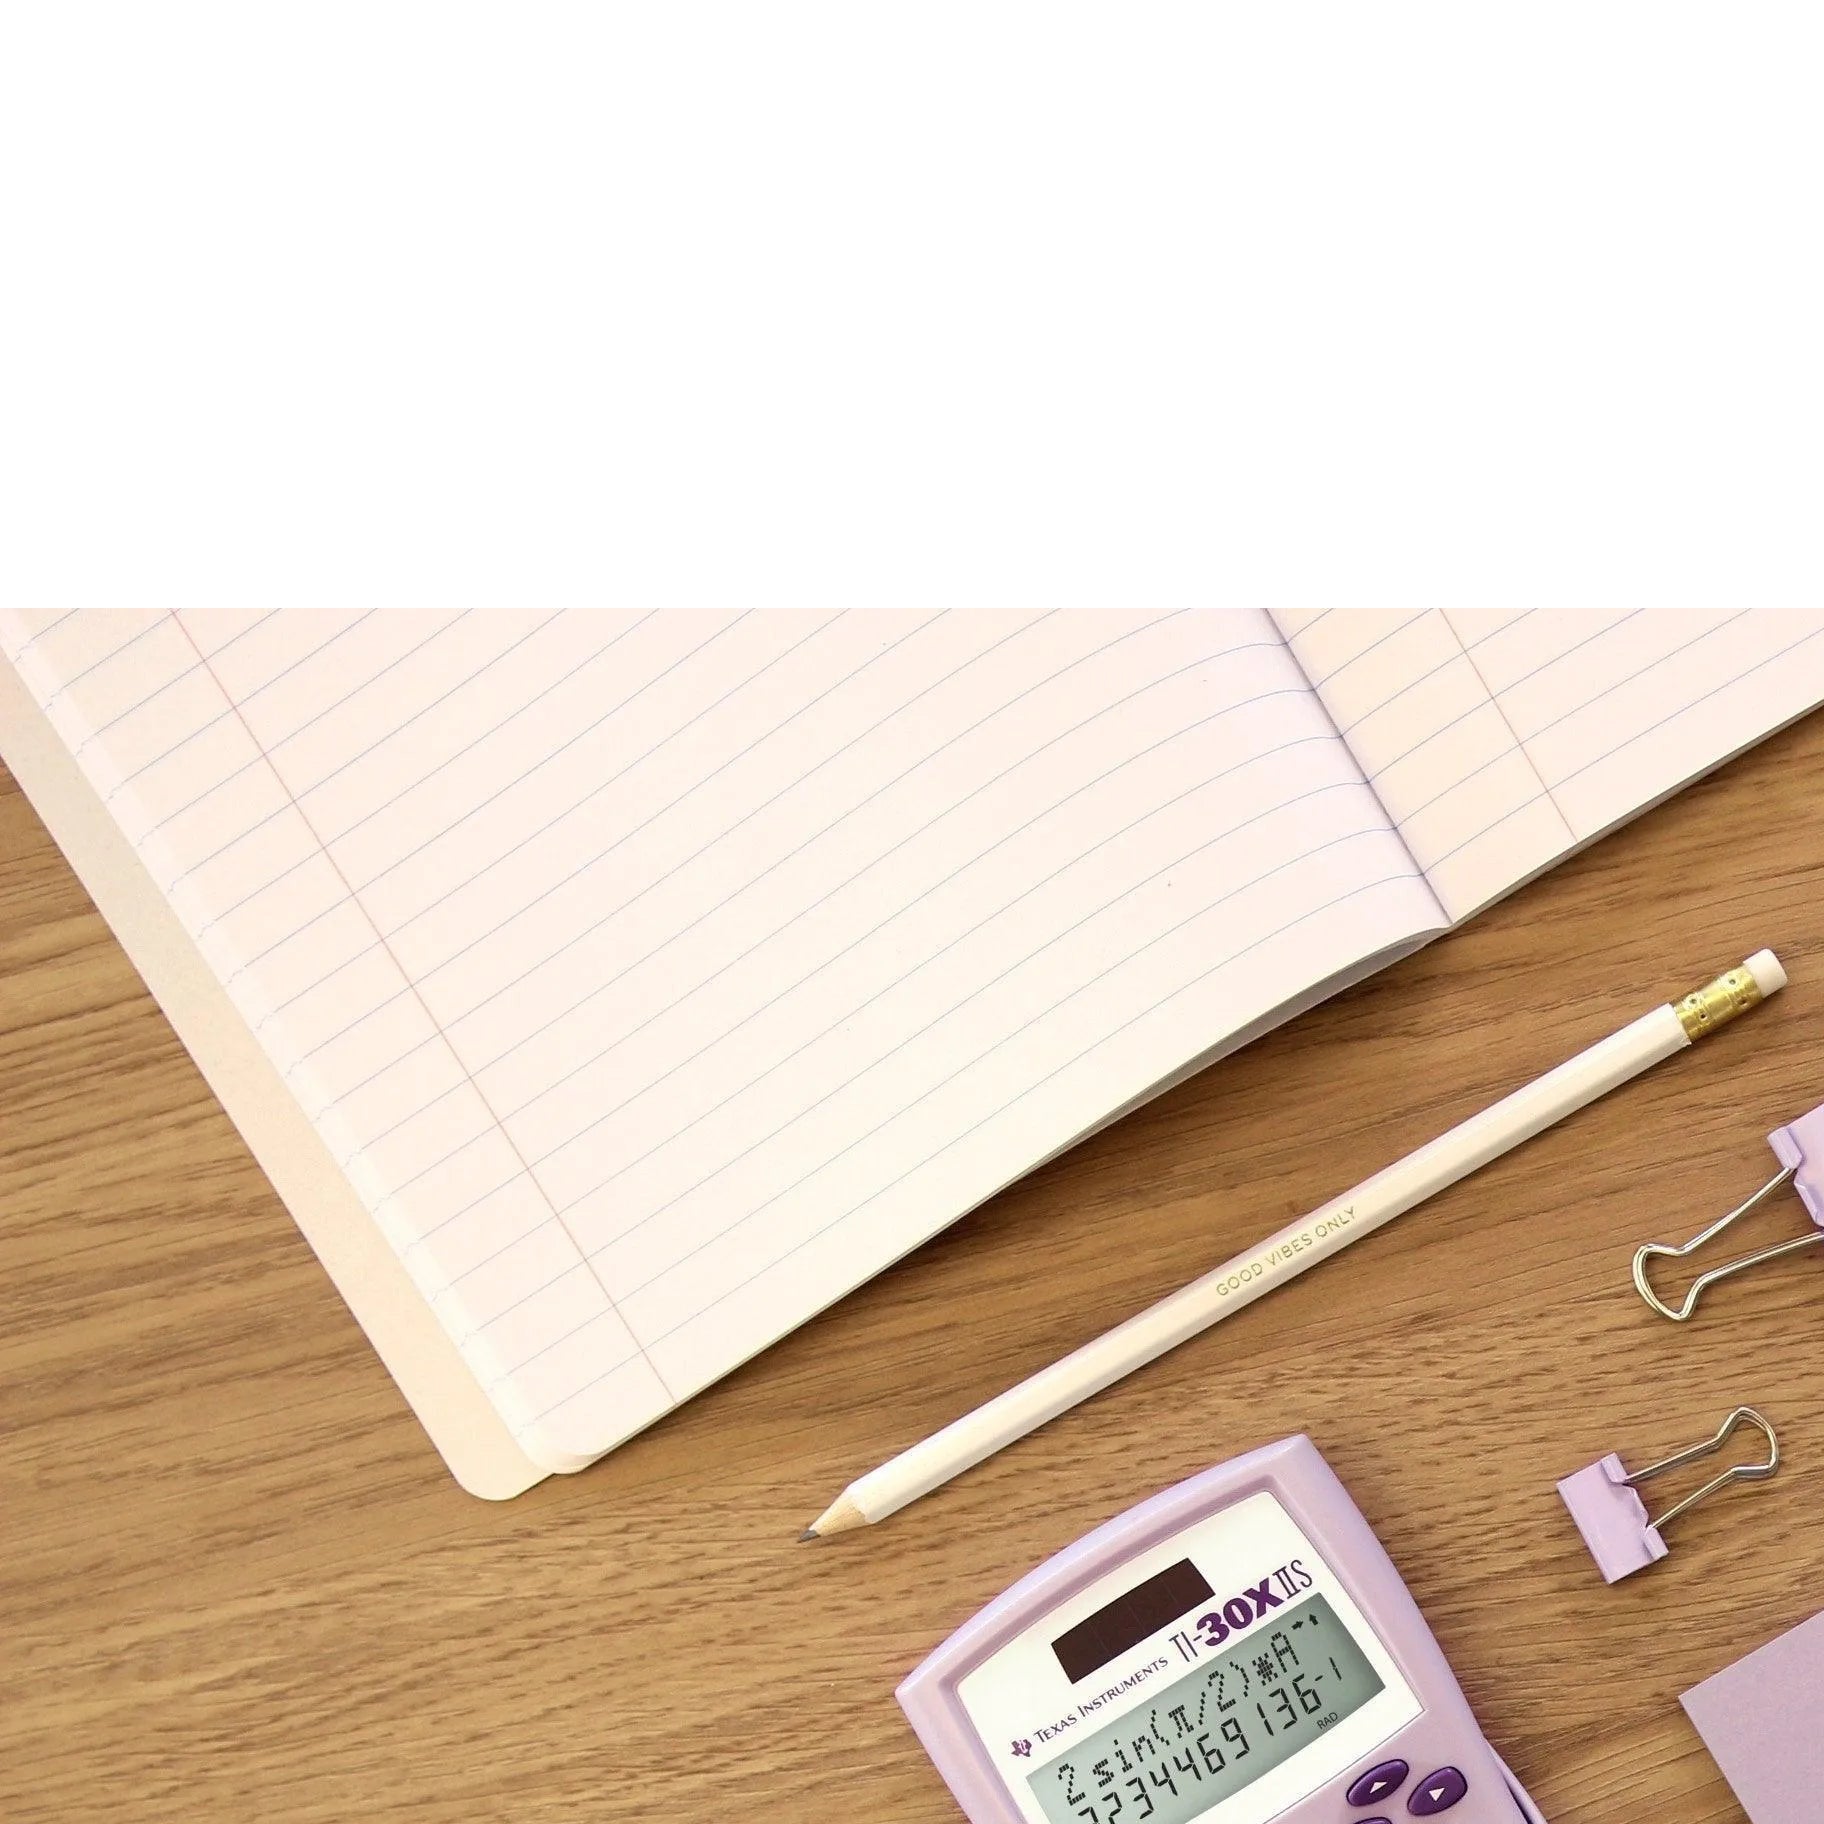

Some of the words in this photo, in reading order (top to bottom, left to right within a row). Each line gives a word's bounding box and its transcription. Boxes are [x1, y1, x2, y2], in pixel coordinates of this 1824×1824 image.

[1216, 1263, 1263, 1296] GOOD
[1265, 1233, 1313, 1266] VIBES
[1315, 1206, 1356, 1238] ONLY
[1033, 1714, 1078, 1743] TEXAS
[1077, 1656, 1169, 1717] INSTRUMENTS
[1317, 1712, 1338, 1729] RAD
